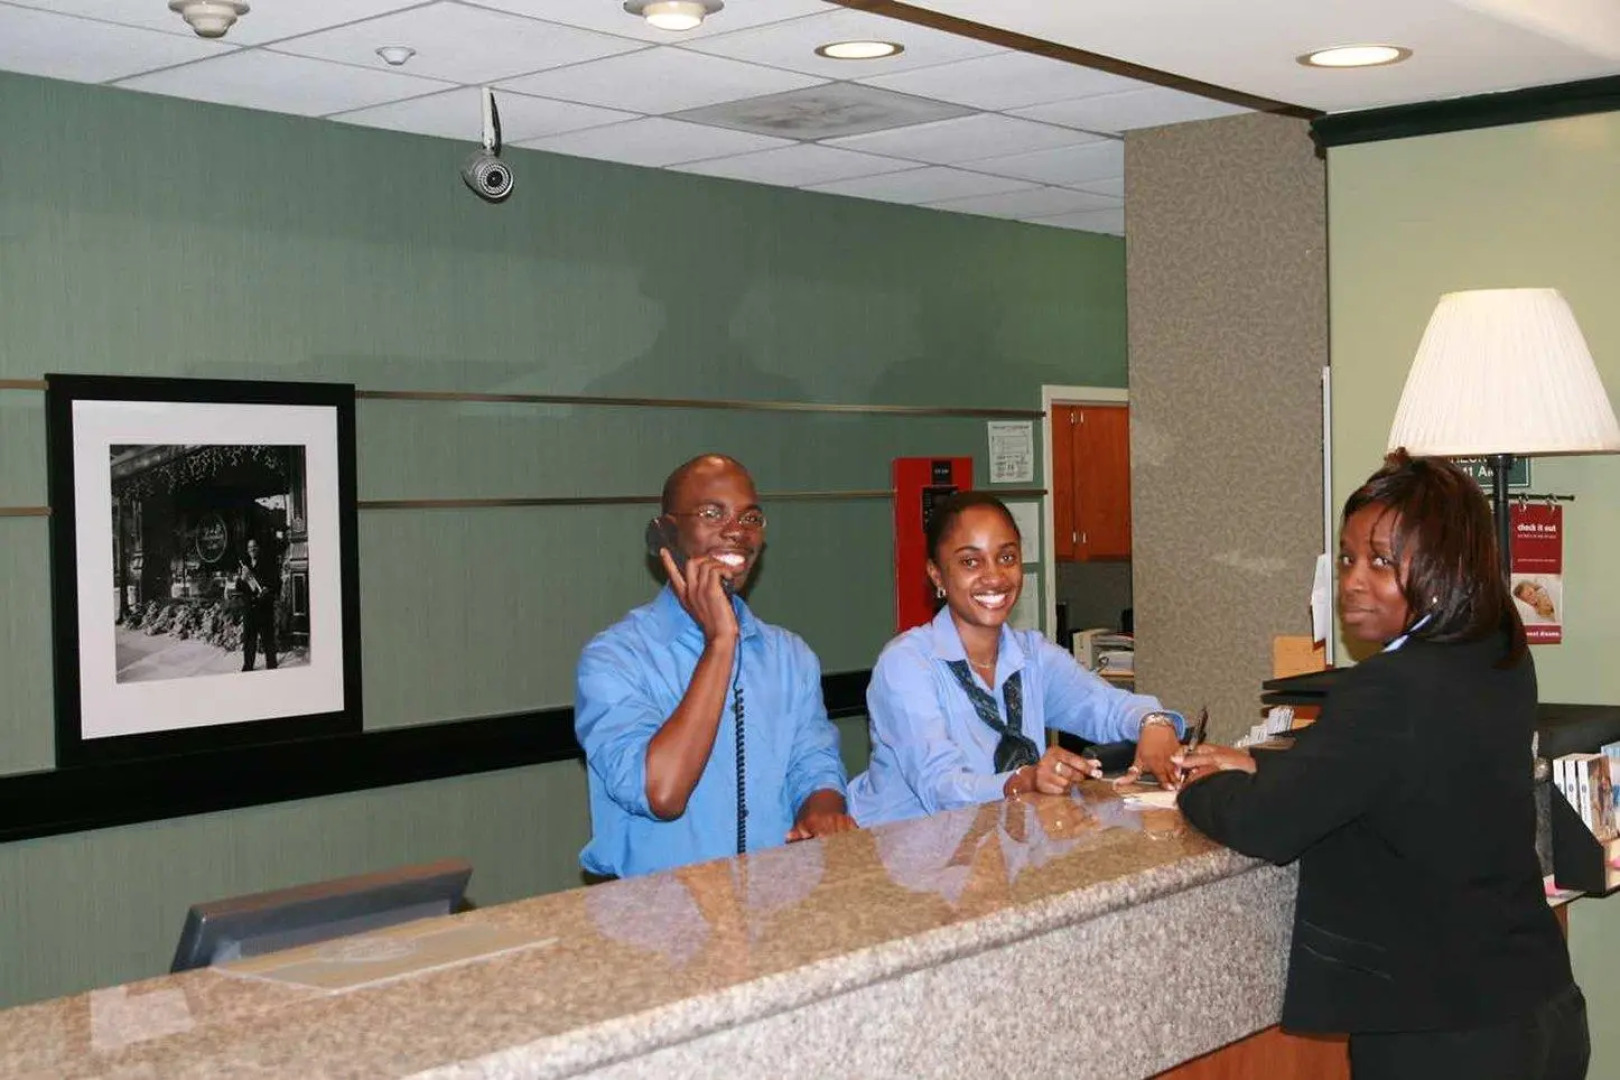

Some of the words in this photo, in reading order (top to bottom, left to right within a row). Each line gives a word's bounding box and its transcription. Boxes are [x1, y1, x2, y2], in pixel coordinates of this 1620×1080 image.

[1517, 523, 1537, 532] check
[1537, 523, 1544, 532] it
[1544, 524, 1556, 532] out
